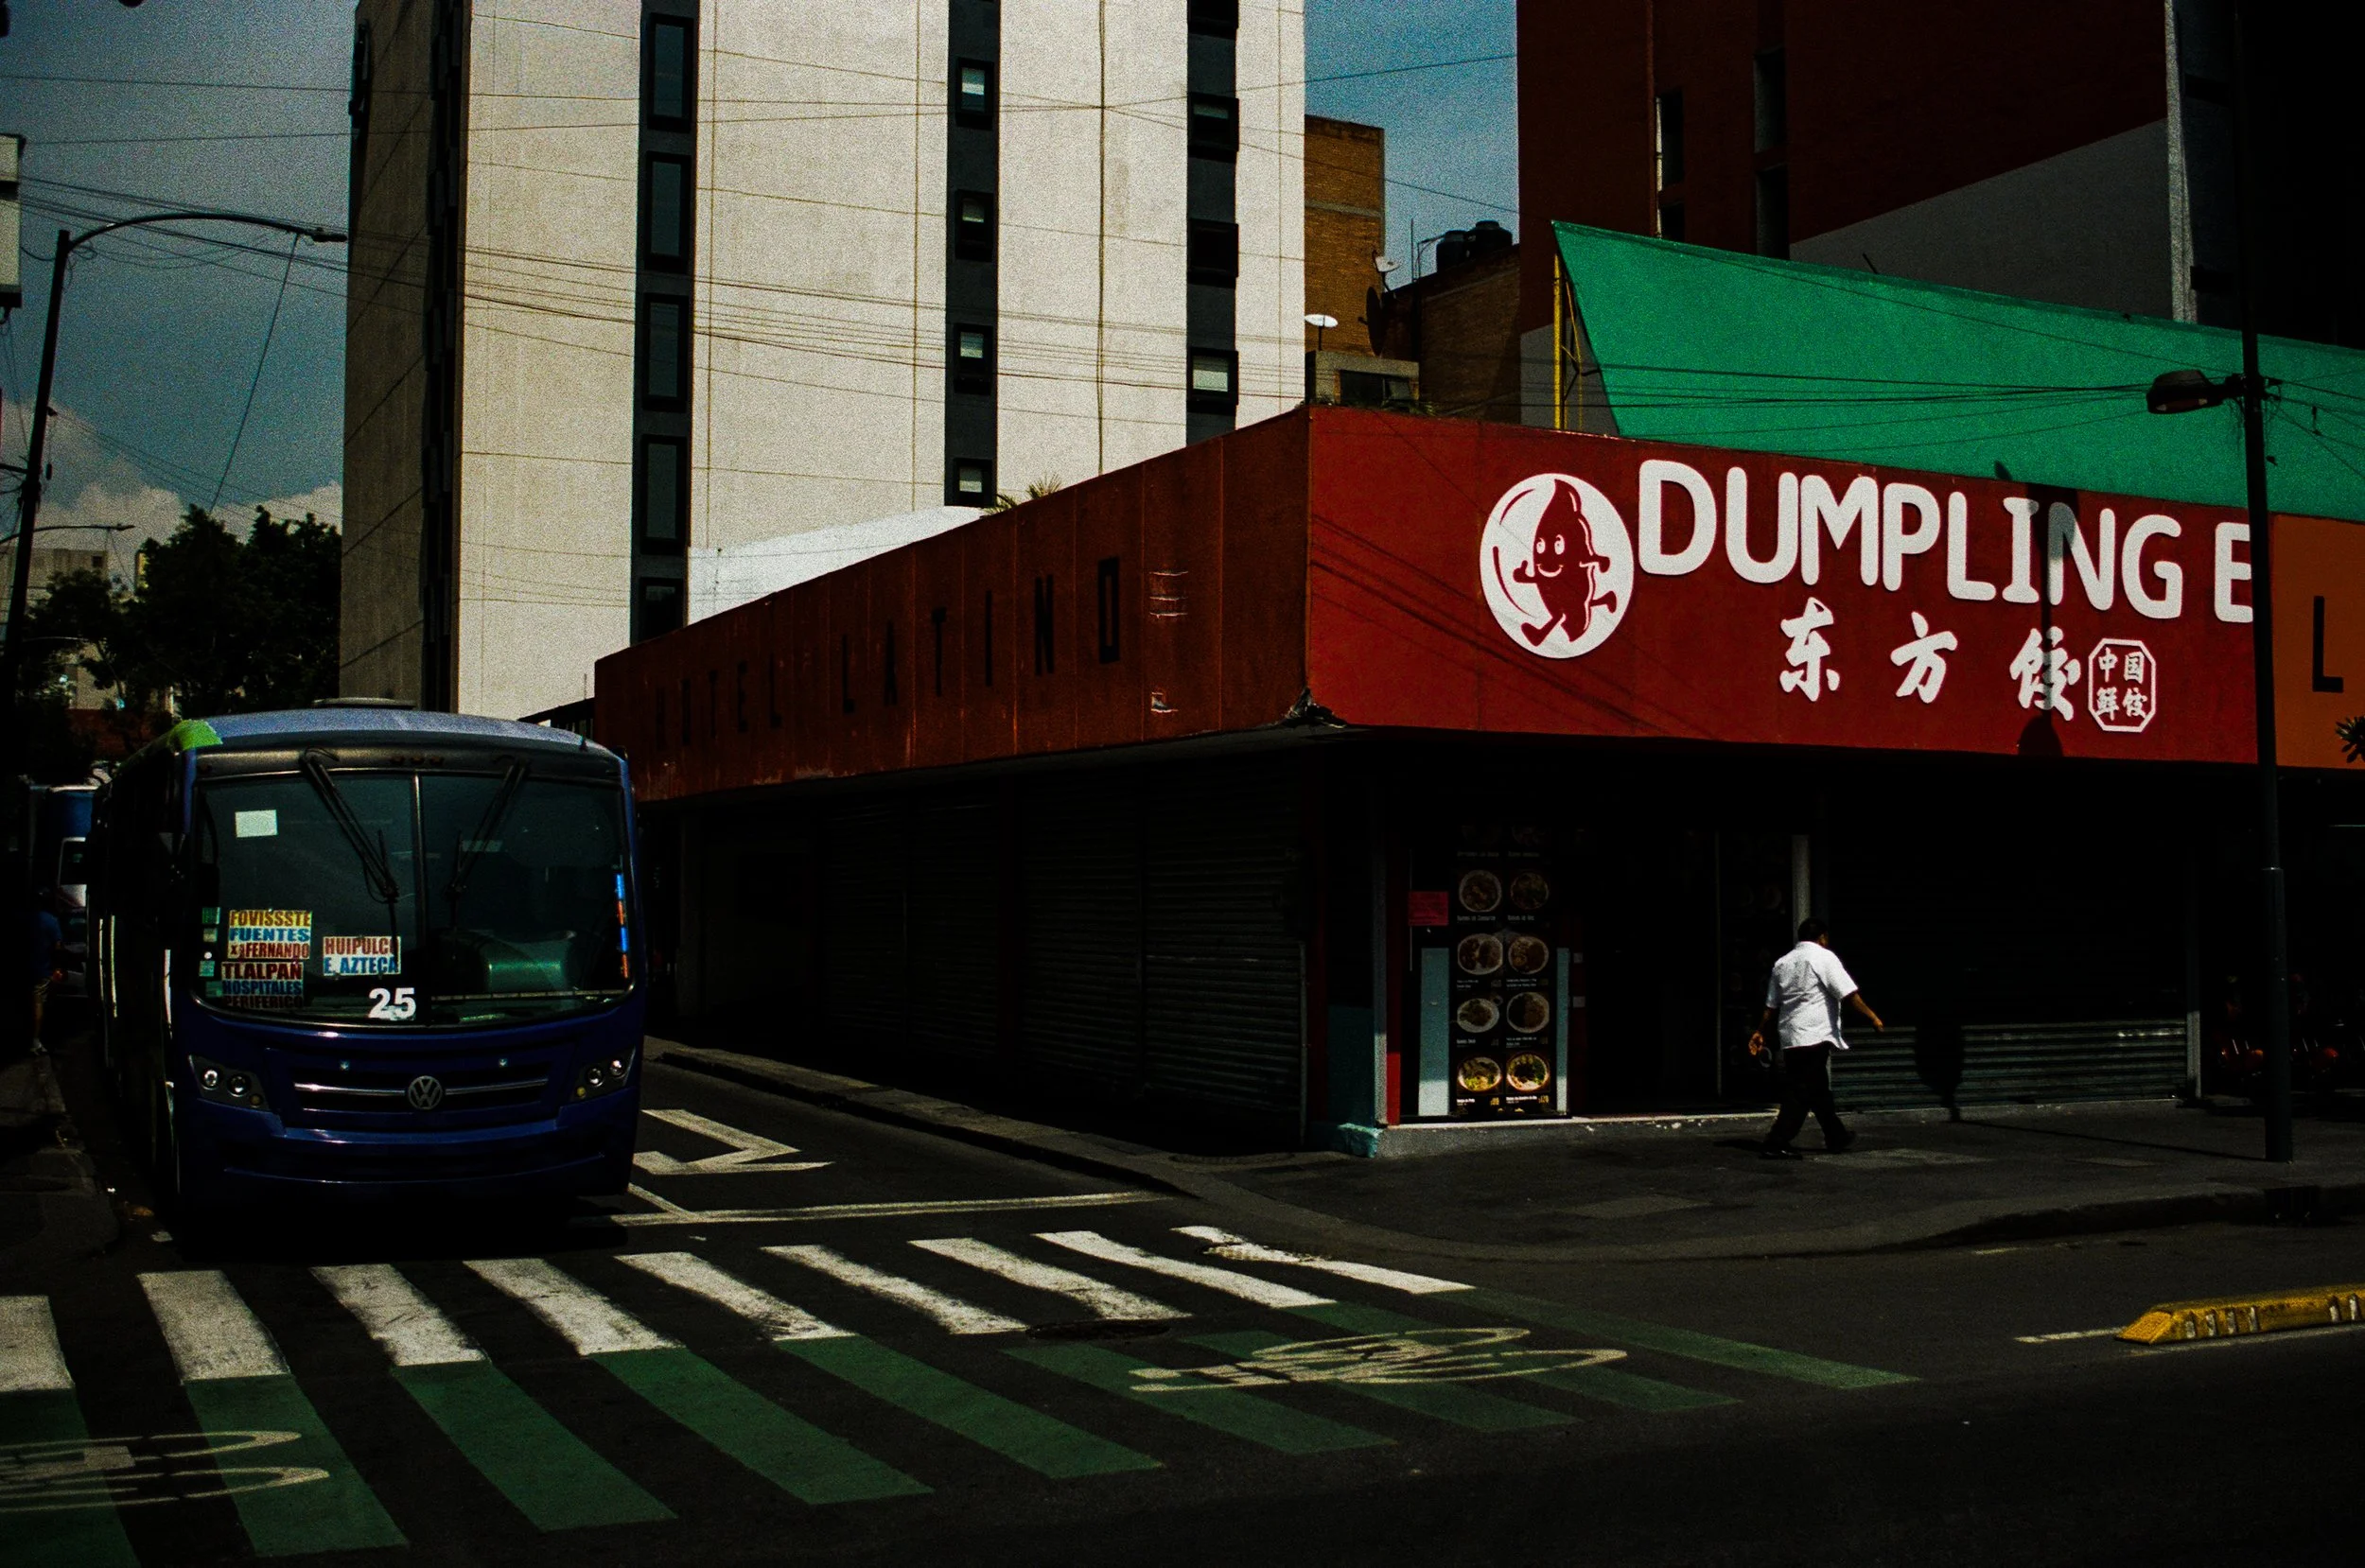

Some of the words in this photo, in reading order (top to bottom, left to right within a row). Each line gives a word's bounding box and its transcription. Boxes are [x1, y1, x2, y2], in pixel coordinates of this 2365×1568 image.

[1638, 459, 2184, 620] DUMPLING
[656, 651, 782, 751] HOTEL
[841, 556, 1120, 712] LATINO
[230, 910, 311, 927] FOVISSSTE
[229, 927, 310, 942] FUENTES
[222, 963, 303, 980] TLALPAN
[340, 956, 398, 974] AZTECA
[222, 981, 302, 995] HOSPITALES
[368, 986, 417, 1021] 25
